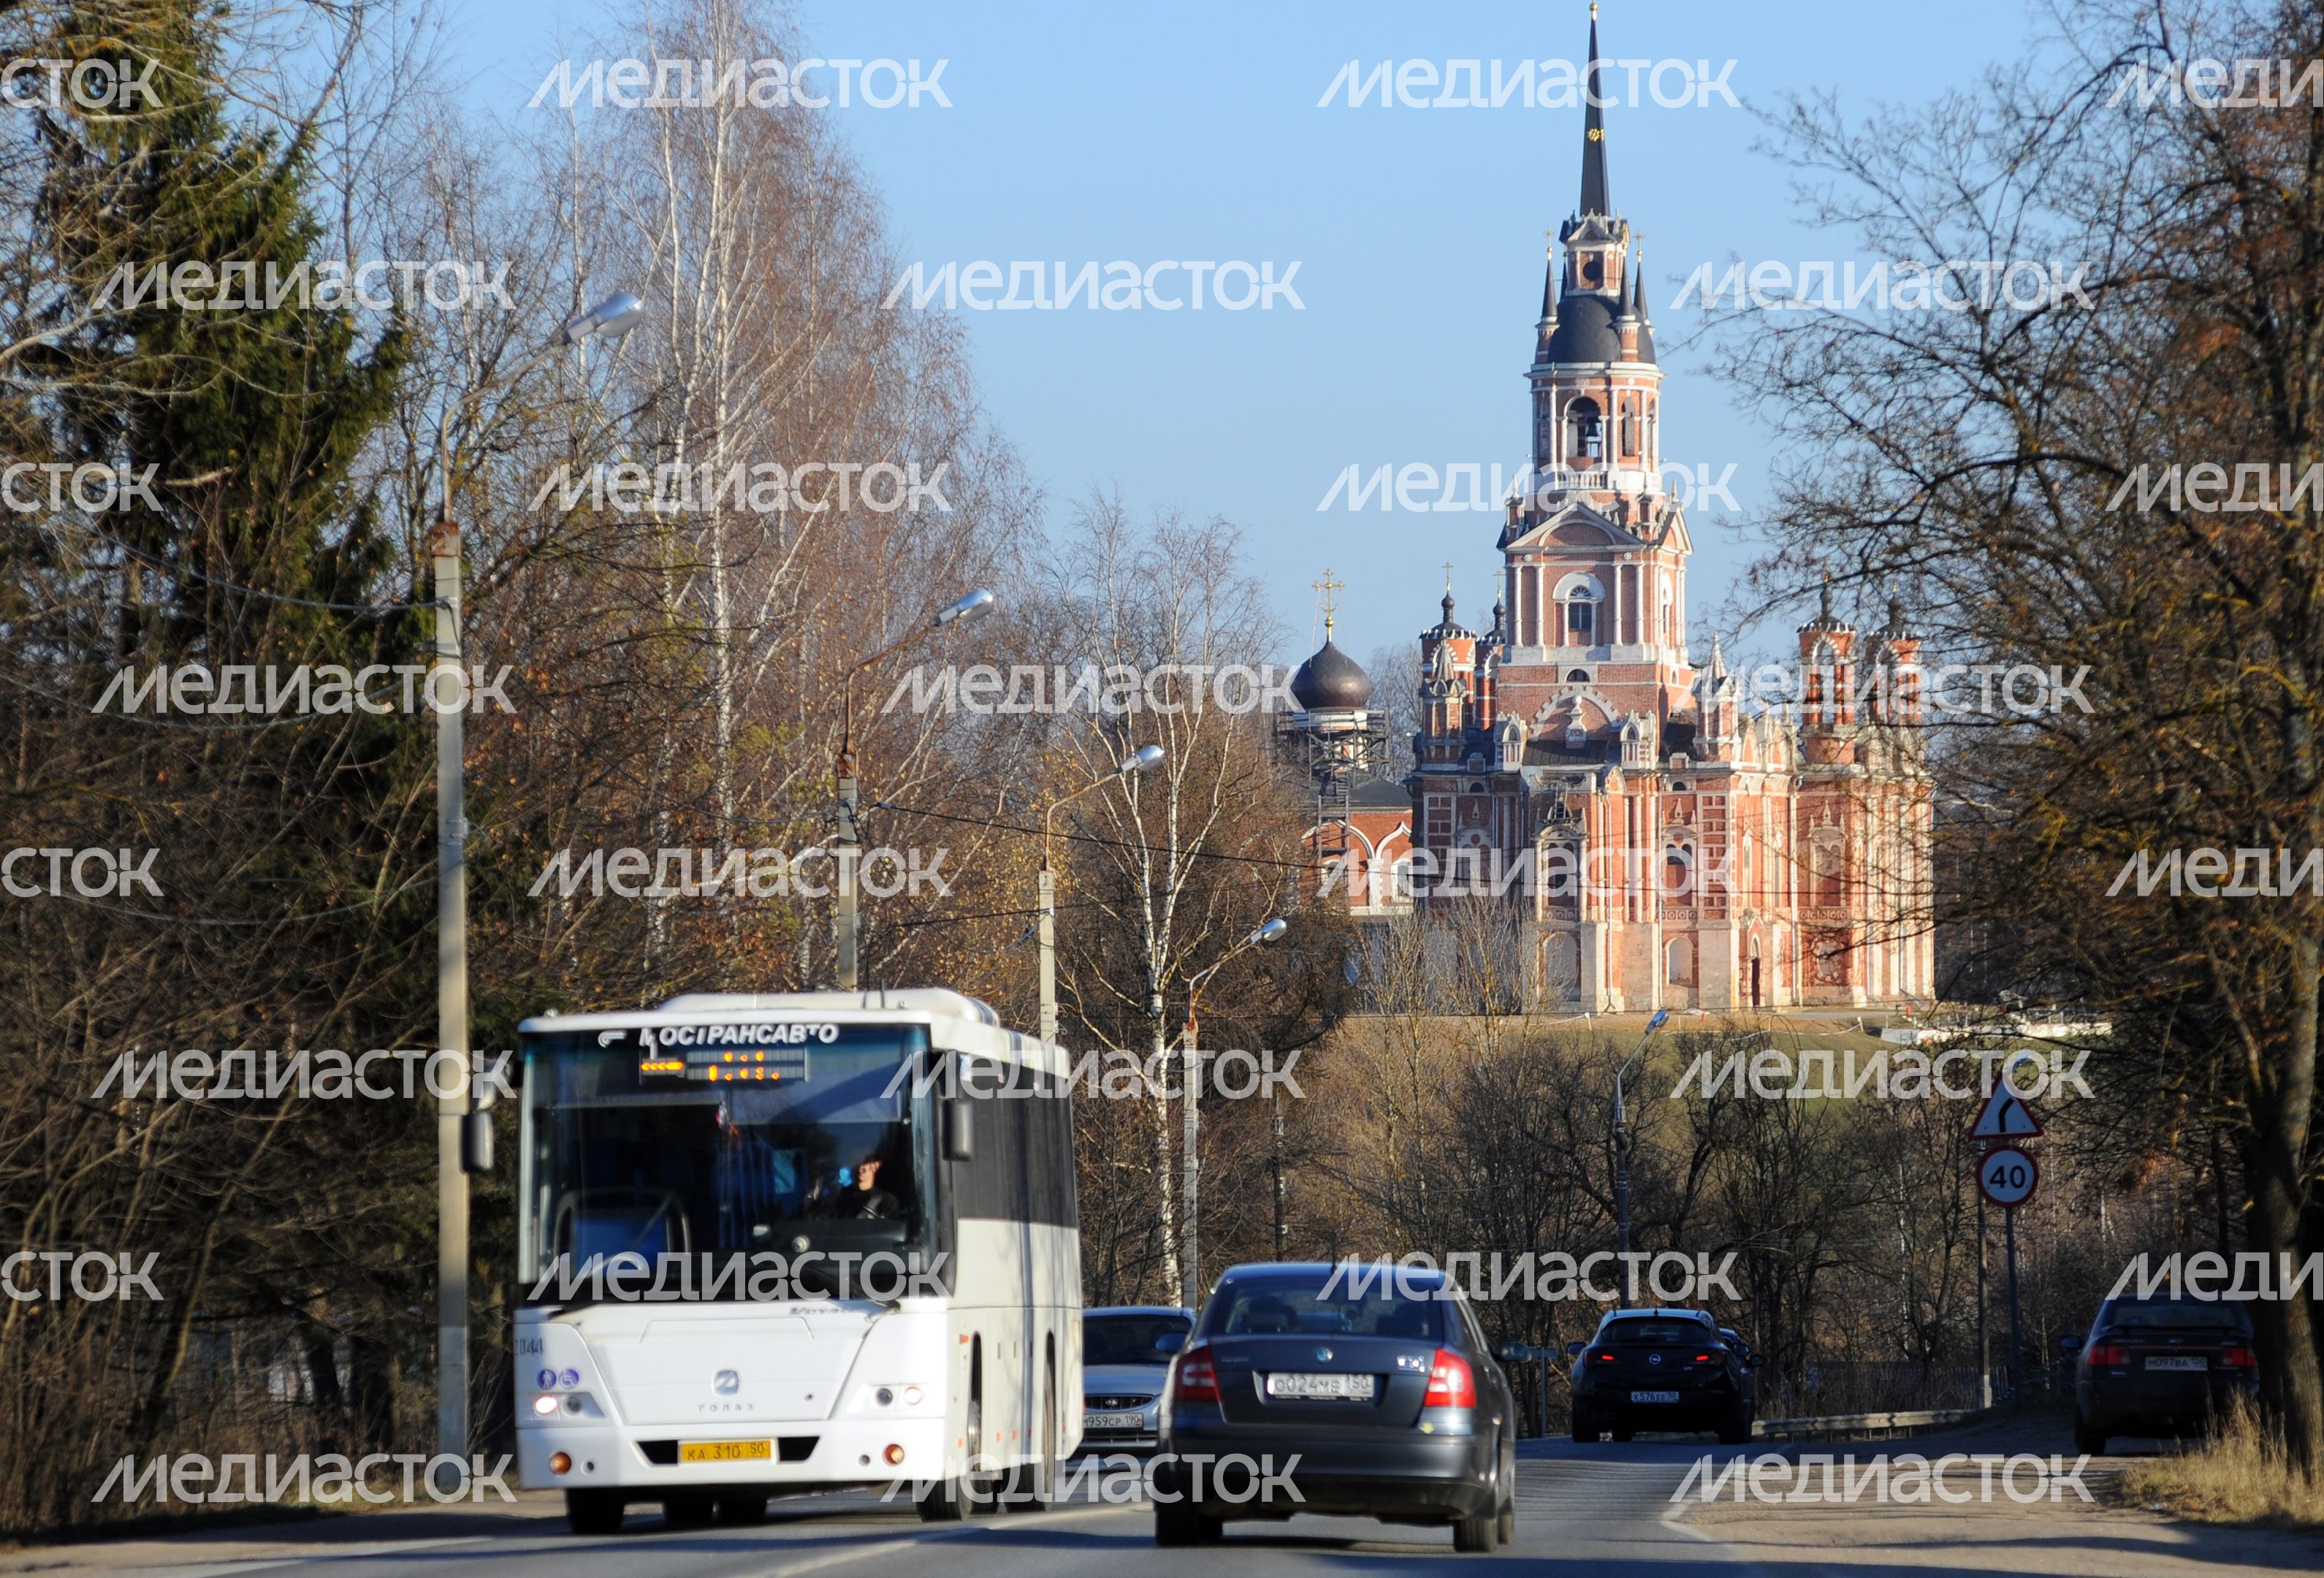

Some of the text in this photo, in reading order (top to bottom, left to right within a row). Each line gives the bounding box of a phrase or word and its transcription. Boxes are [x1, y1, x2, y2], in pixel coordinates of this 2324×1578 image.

[1989, 1165, 2026, 1189] 40
[1126, 1414, 1138, 1424] 190
[687, 1443, 765, 1460] КА 310 50
